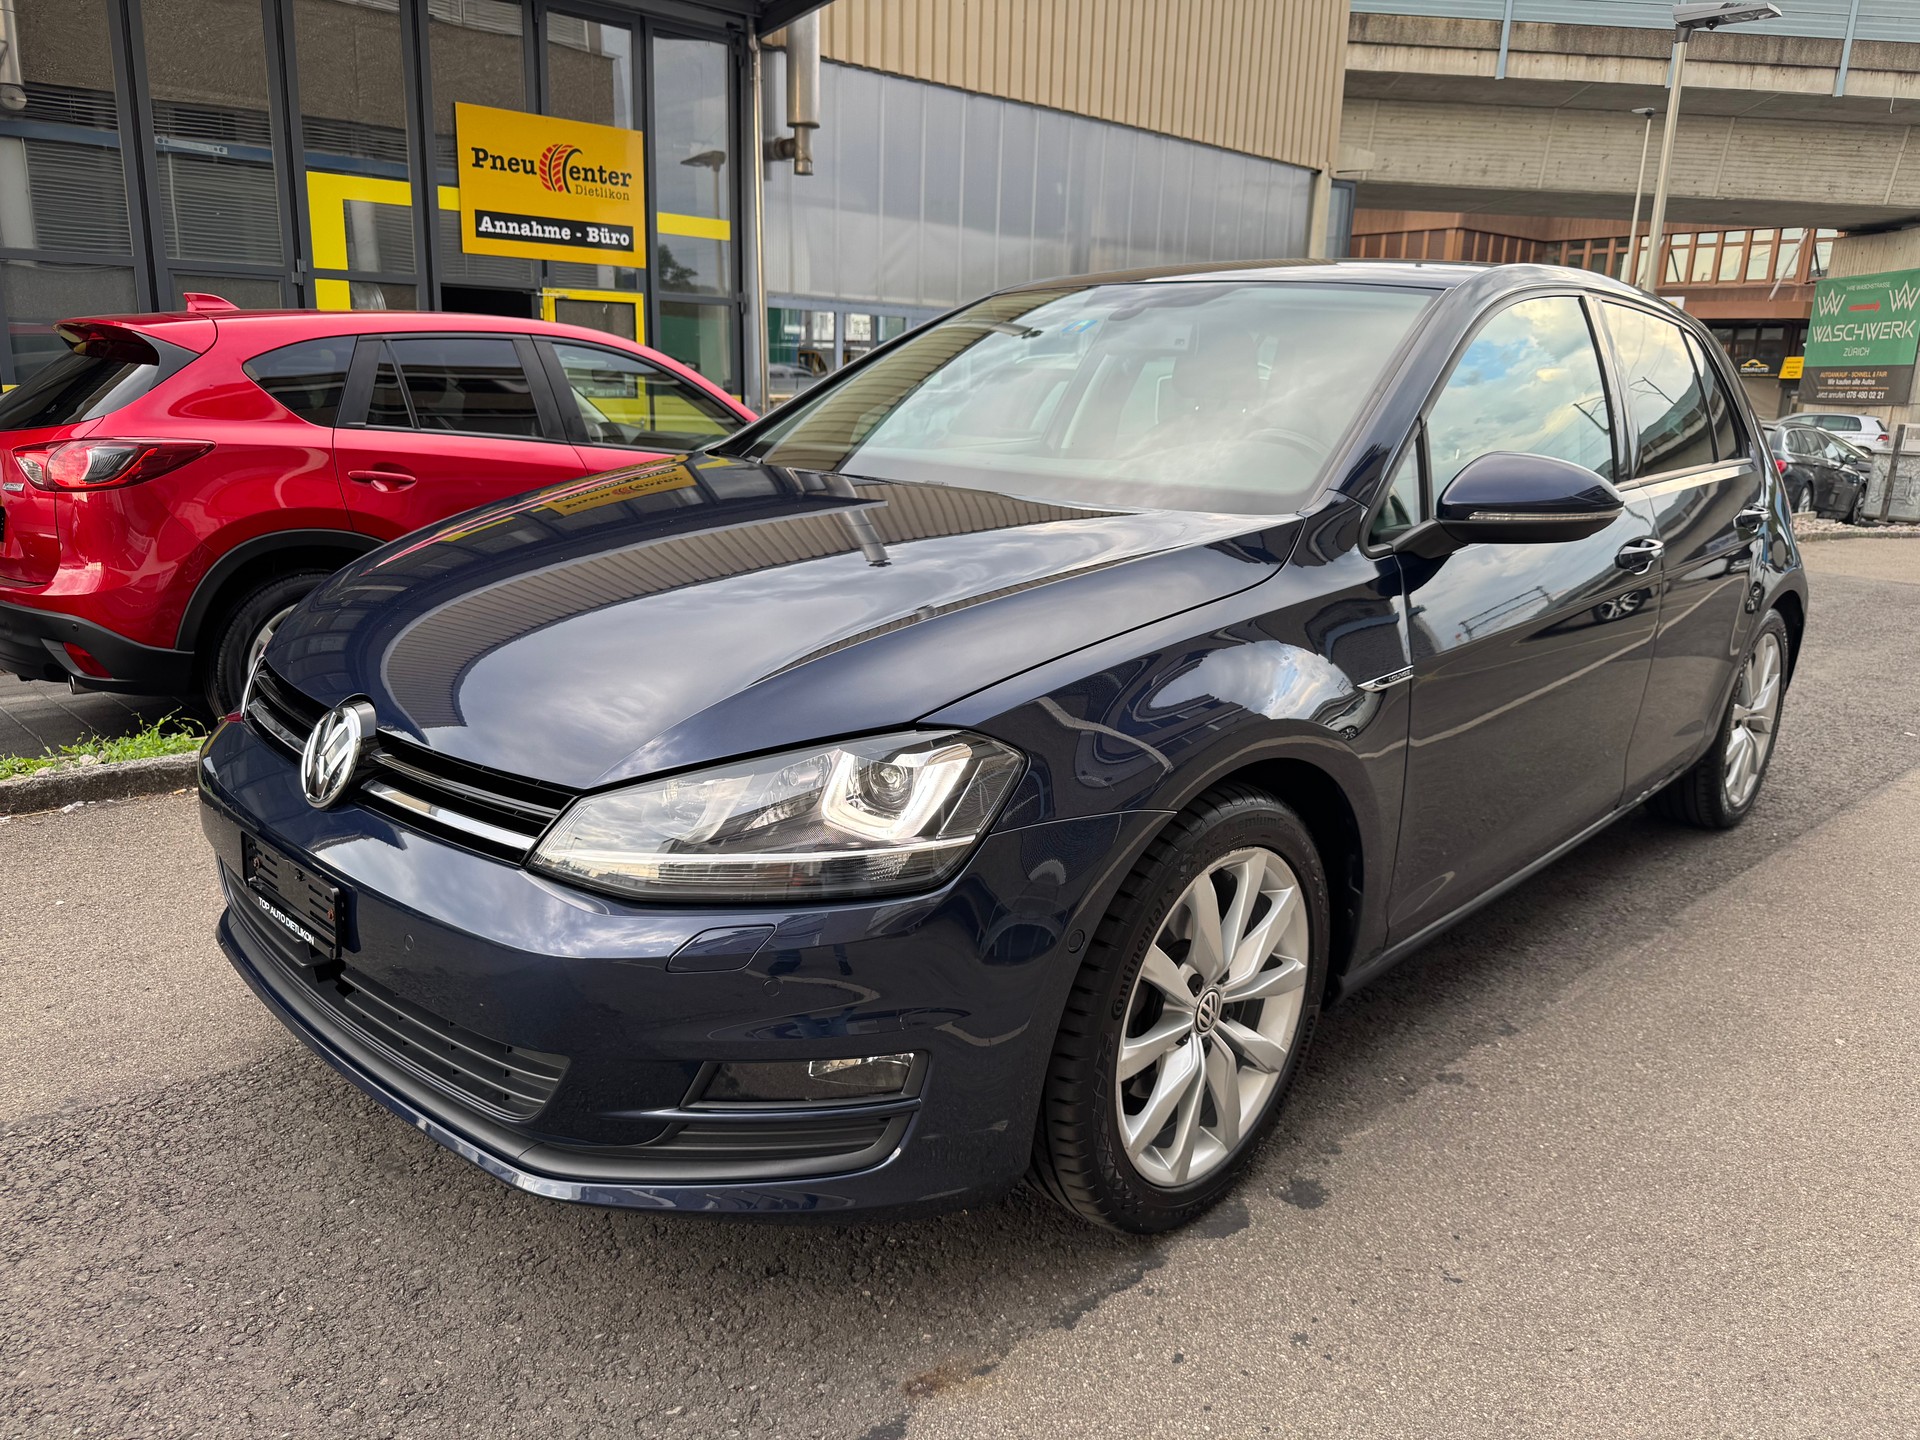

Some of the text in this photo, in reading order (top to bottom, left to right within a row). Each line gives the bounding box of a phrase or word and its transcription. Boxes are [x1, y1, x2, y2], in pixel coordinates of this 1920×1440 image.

[471, 147, 537, 175] Pneu
[575, 184, 630, 201] Dietlikon
[478, 215, 571, 241] Annahme
[586, 226, 630, 247] Büro
[1812, 320, 1917, 343] WASCHWERK
[1843, 346, 1871, 357] ZÜRICH
[1877, 391, 1885, 399] 21
[258, 896, 270, 910] TOP
[270, 906, 285, 923] AUTO
